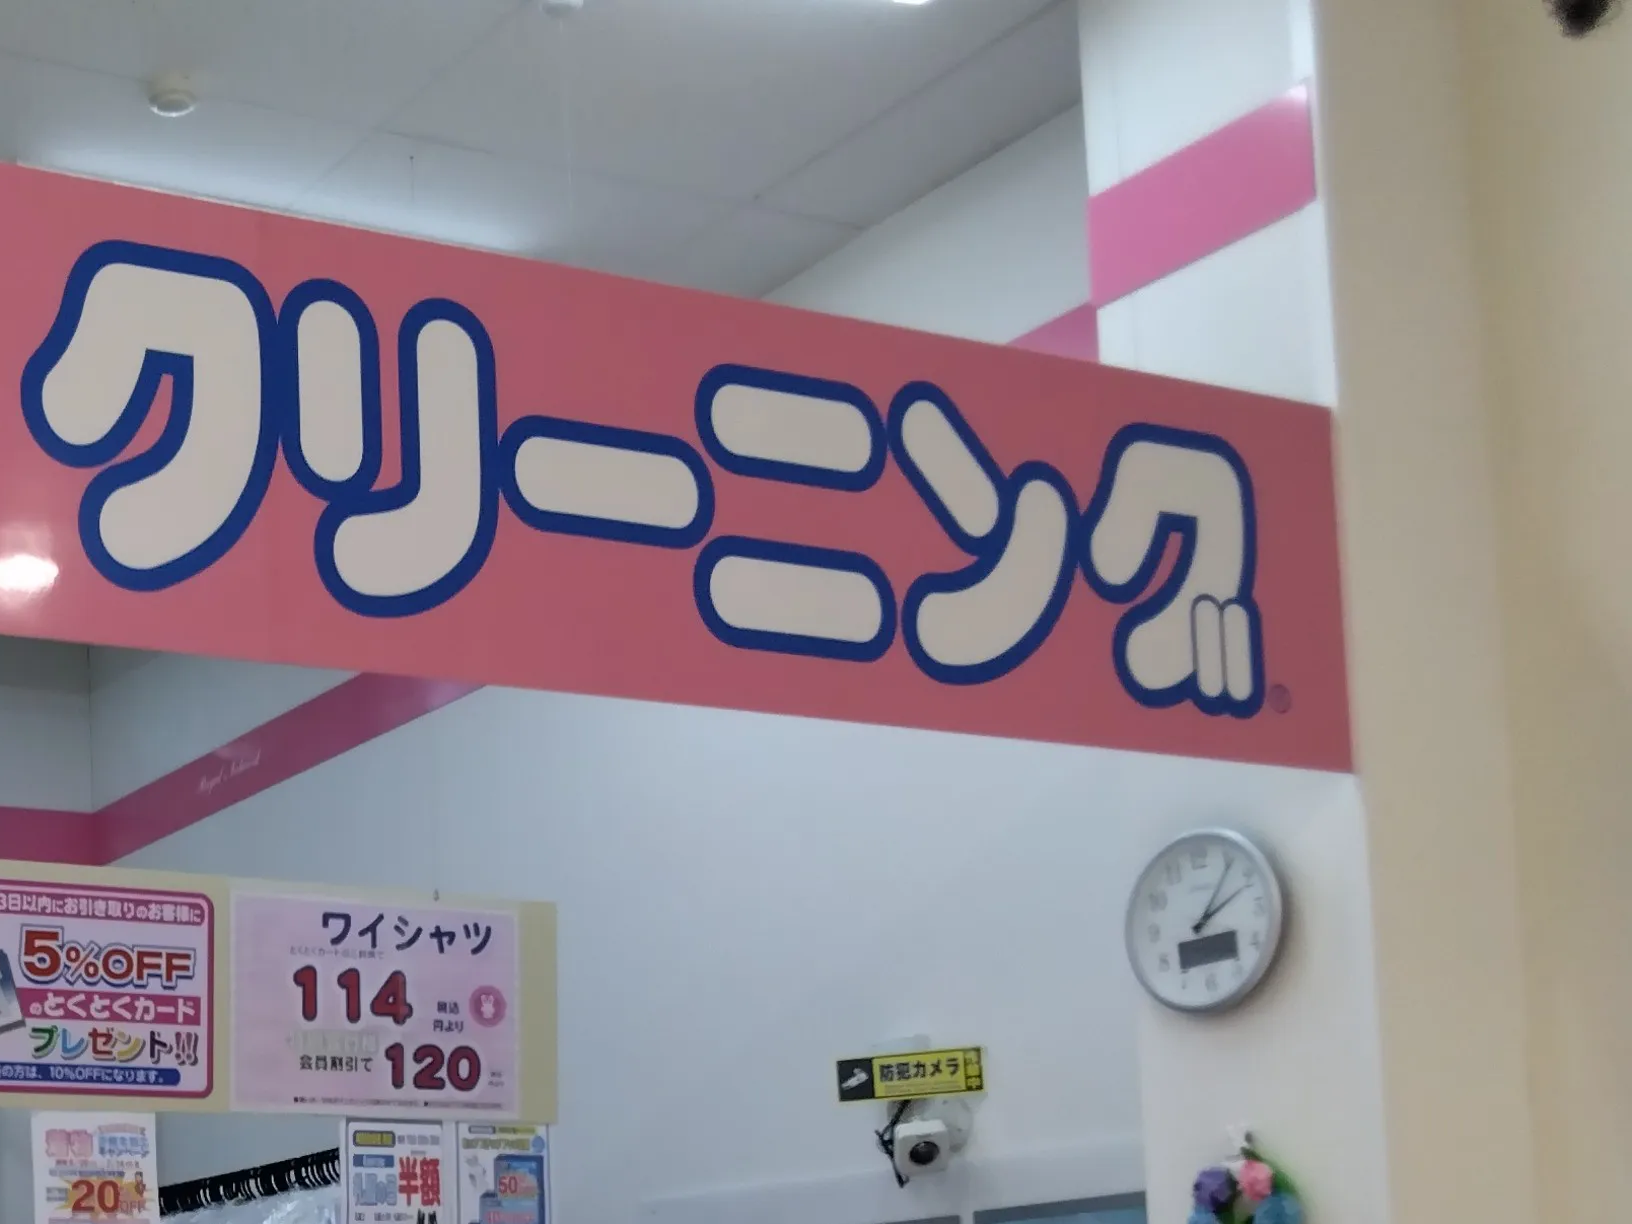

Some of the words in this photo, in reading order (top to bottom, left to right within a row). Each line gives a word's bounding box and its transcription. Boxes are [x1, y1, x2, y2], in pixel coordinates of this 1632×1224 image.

[20, 239, 1265, 718] クリーニング
[21, 925, 196, 986] 5%OFF
[321, 911, 493, 956] ワイシャツ
[29, 991, 197, 1024] のとくとくカード
[293, 964, 414, 1026] 114
[384, 1042, 482, 1092] 120
[878, 1057, 961, 1083] 防犯カメラ
[71, 1179, 121, 1214] 20
